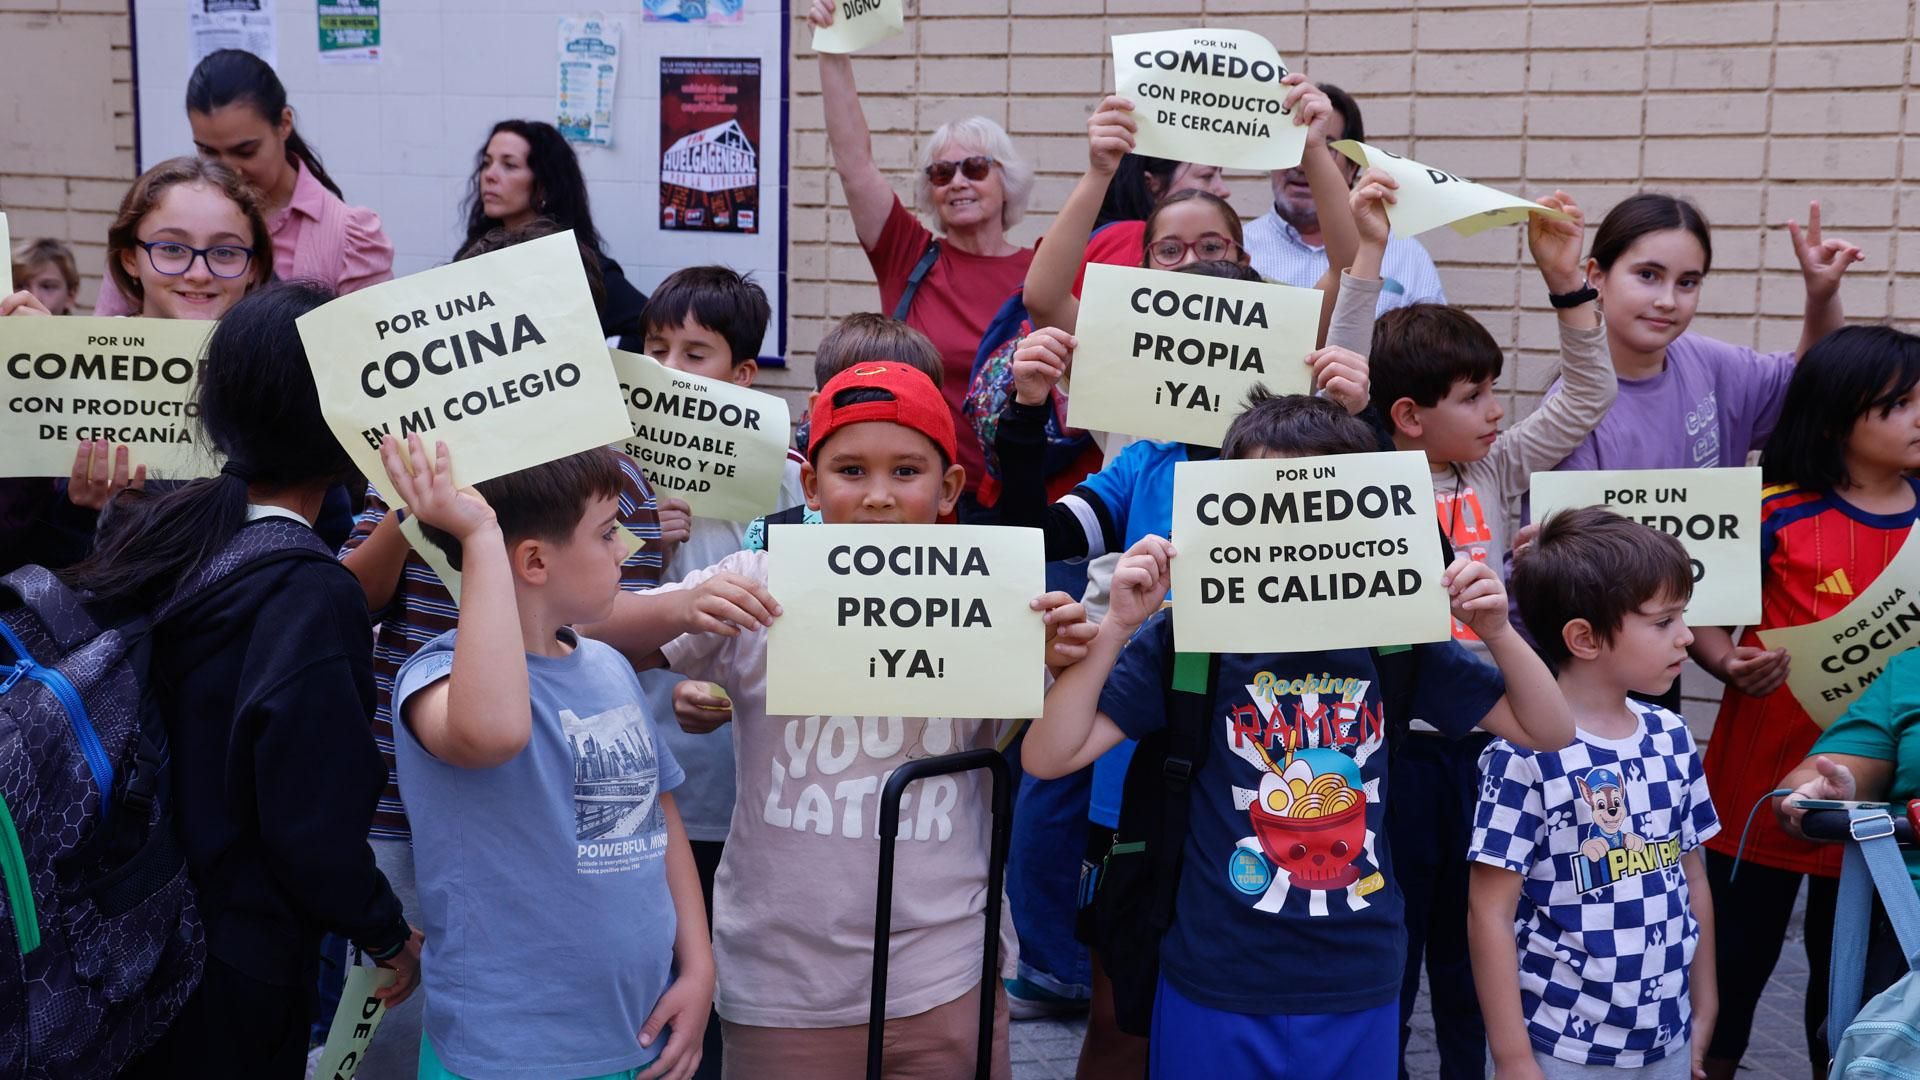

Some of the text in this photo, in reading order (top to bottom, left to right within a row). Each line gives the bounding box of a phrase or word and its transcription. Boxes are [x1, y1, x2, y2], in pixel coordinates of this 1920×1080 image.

[1194, 39, 1237, 50] POR UN
[1138, 83, 1175, 101] CON
[1157, 110, 1270, 138] DE CERCANÍA
[376, 290, 495, 340] POR UNA
[1131, 287, 1268, 329] COCINA
[88, 336, 144, 346] POR UN
[361, 313, 547, 399] COCINA
[1132, 332, 1265, 374] PROPIA
[672, 379, 708, 392] POR UN
[1156, 380, 1220, 412] ¡YA!
[9, 397, 203, 417] CON PRODUCTO
[362, 363, 581, 450] EN MI COLEGIO
[40, 423, 192, 443] DE CERCANÍA
[625, 443, 736, 478] SEGURO Y DE
[1276, 466, 1336, 481] POR UN
[1196, 484, 1416, 526] COMEDOR
[1604, 488, 1687, 505] POR UN
[827, 545, 990, 576] COCINA
[1210, 538, 1409, 563] CON PRODUCTOS
[1201, 568, 1422, 604] DE CALIDAD
[838, 597, 992, 628] PROPIA
[1832, 588, 1907, 645] POR UNA
[1820, 600, 1920, 674] COCIN
[869, 649, 944, 678] ¡YA!
[1253, 671, 1362, 703] Rocking
[1821, 683, 1853, 702] EN
[1231, 701, 1384, 749] RAMEN
[784, 716, 904, 779] YOU
[577, 838, 648, 858] POWERFUL
[1608, 842, 1659, 881] PAW
[353, 996, 382, 1039] DE
